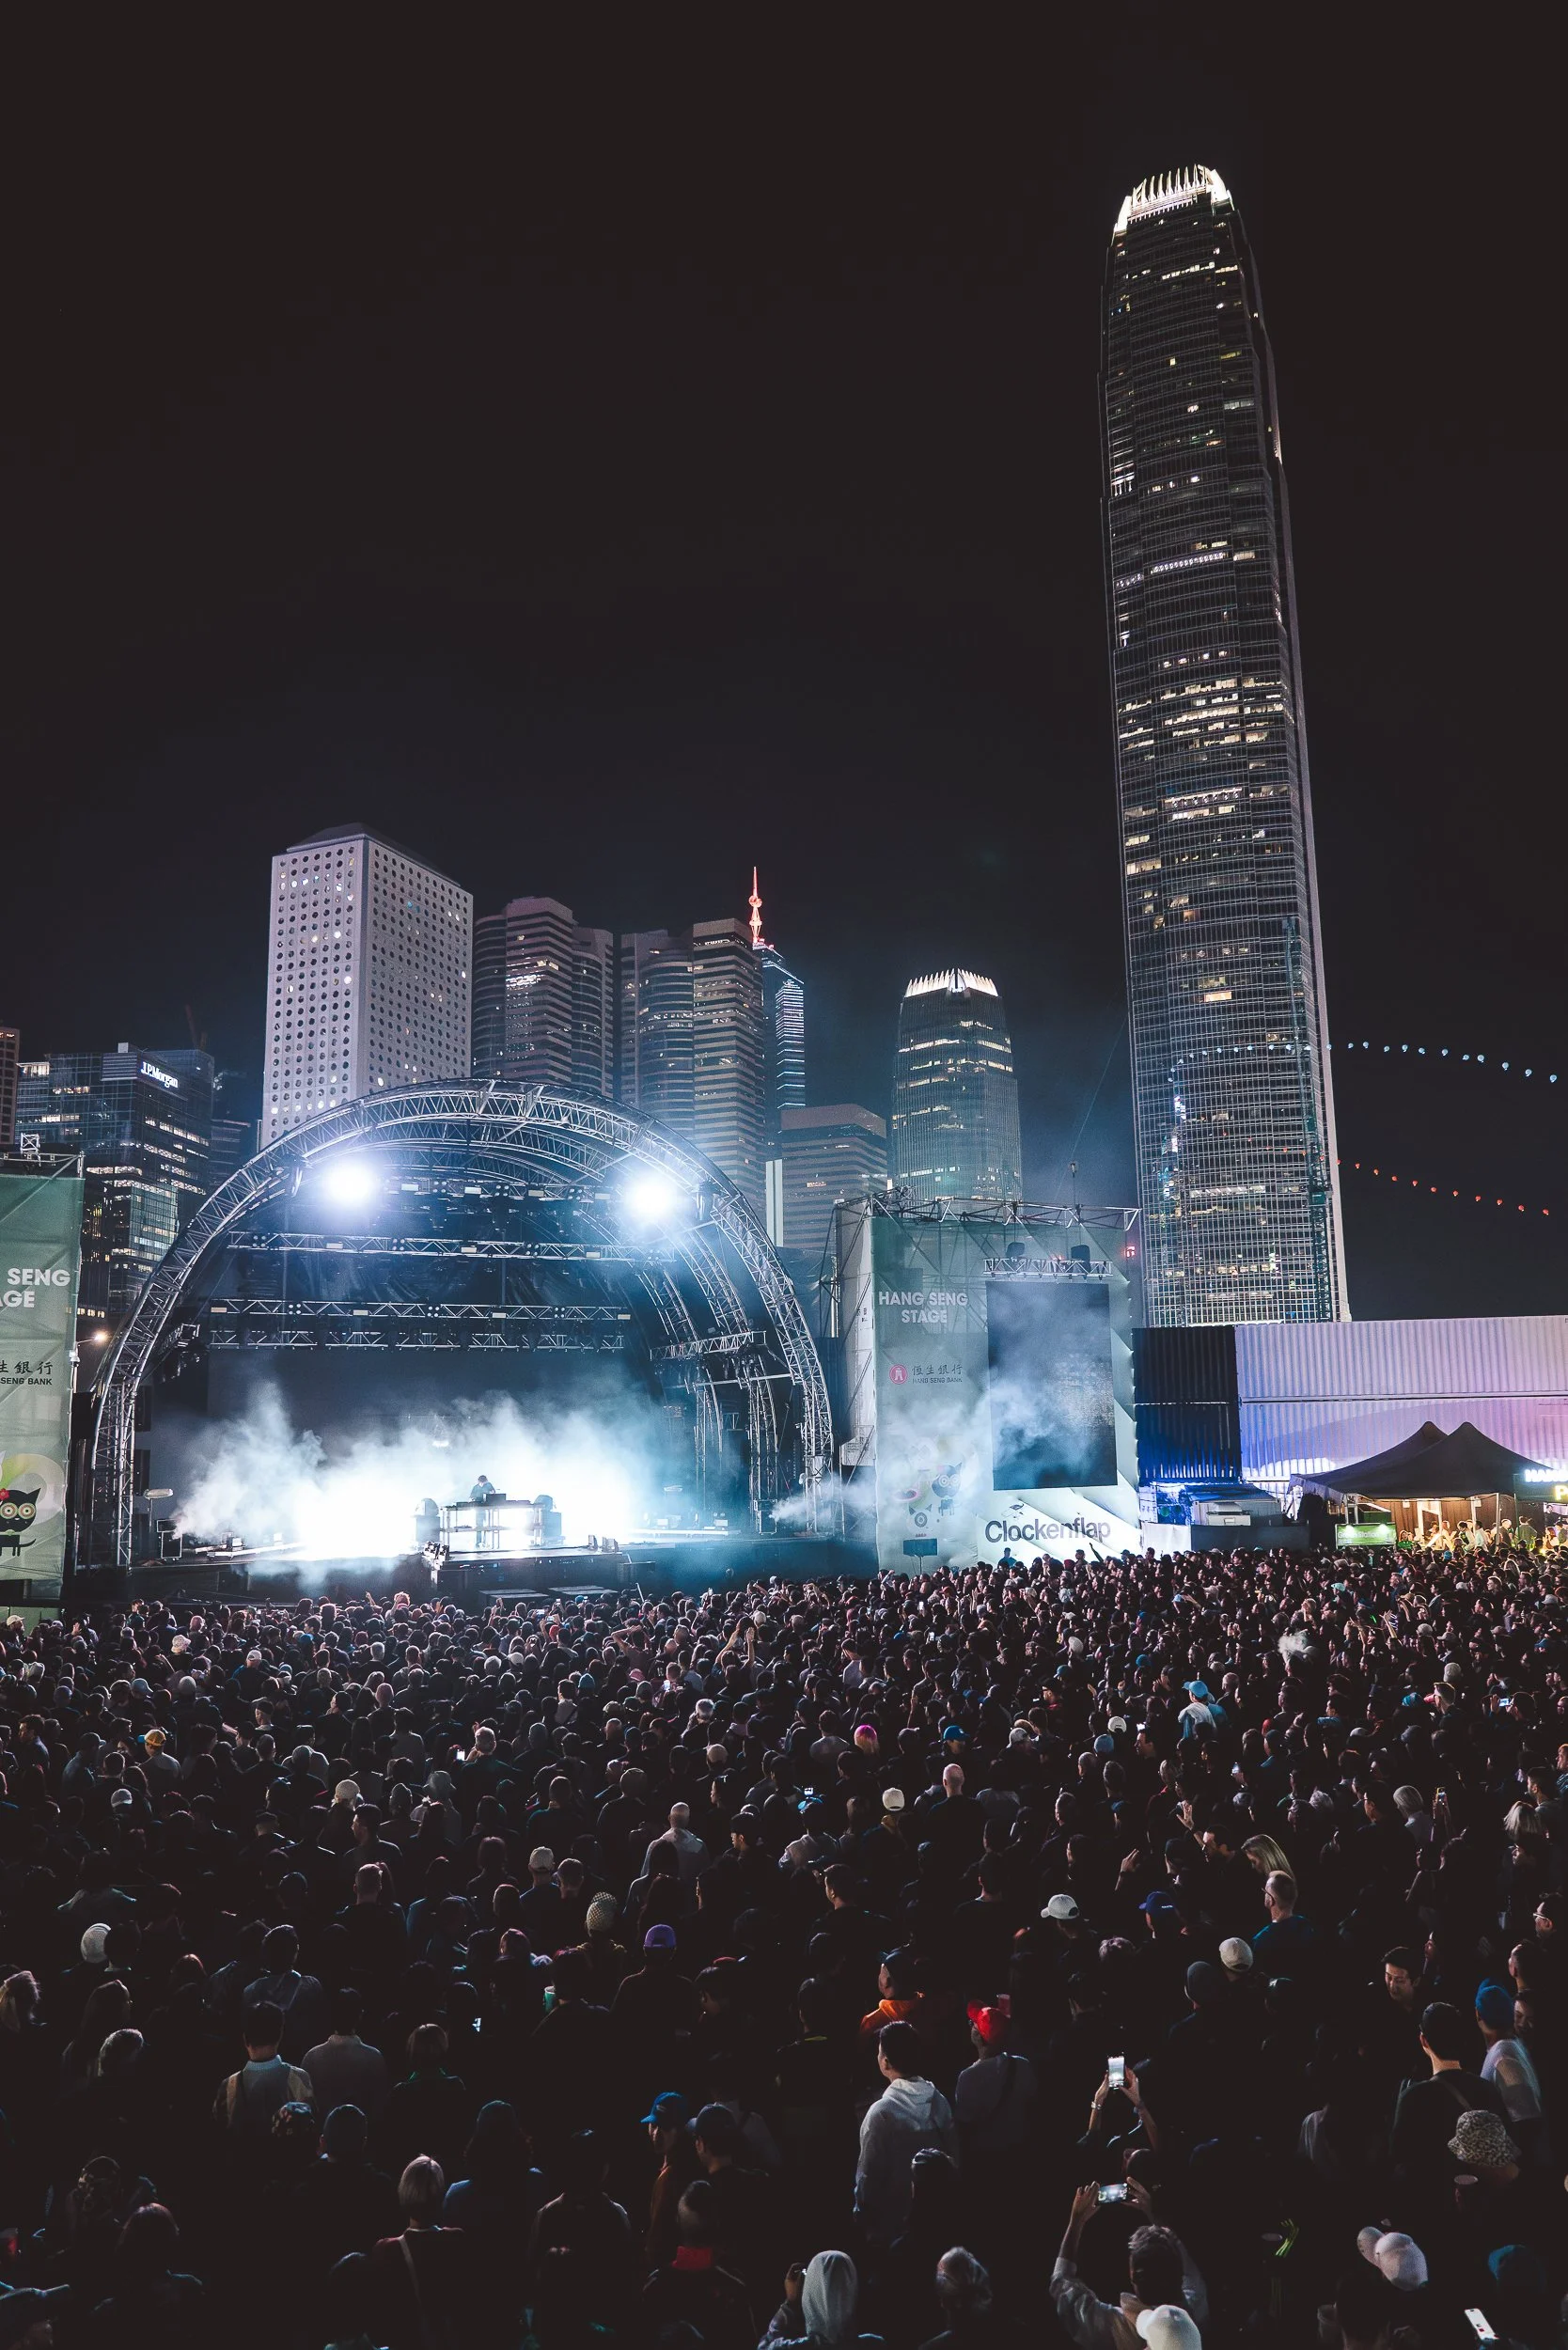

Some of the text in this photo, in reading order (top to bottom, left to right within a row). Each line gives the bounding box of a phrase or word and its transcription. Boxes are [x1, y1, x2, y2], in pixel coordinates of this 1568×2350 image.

[7, 1267, 71, 1287] SENG
[878, 1291, 969, 1307] HANG SENG
[901, 1308, 949, 1324] STAGE
[27, 1377, 53, 1386] BANK
[985, 1517, 1111, 1543] Clockenflap
